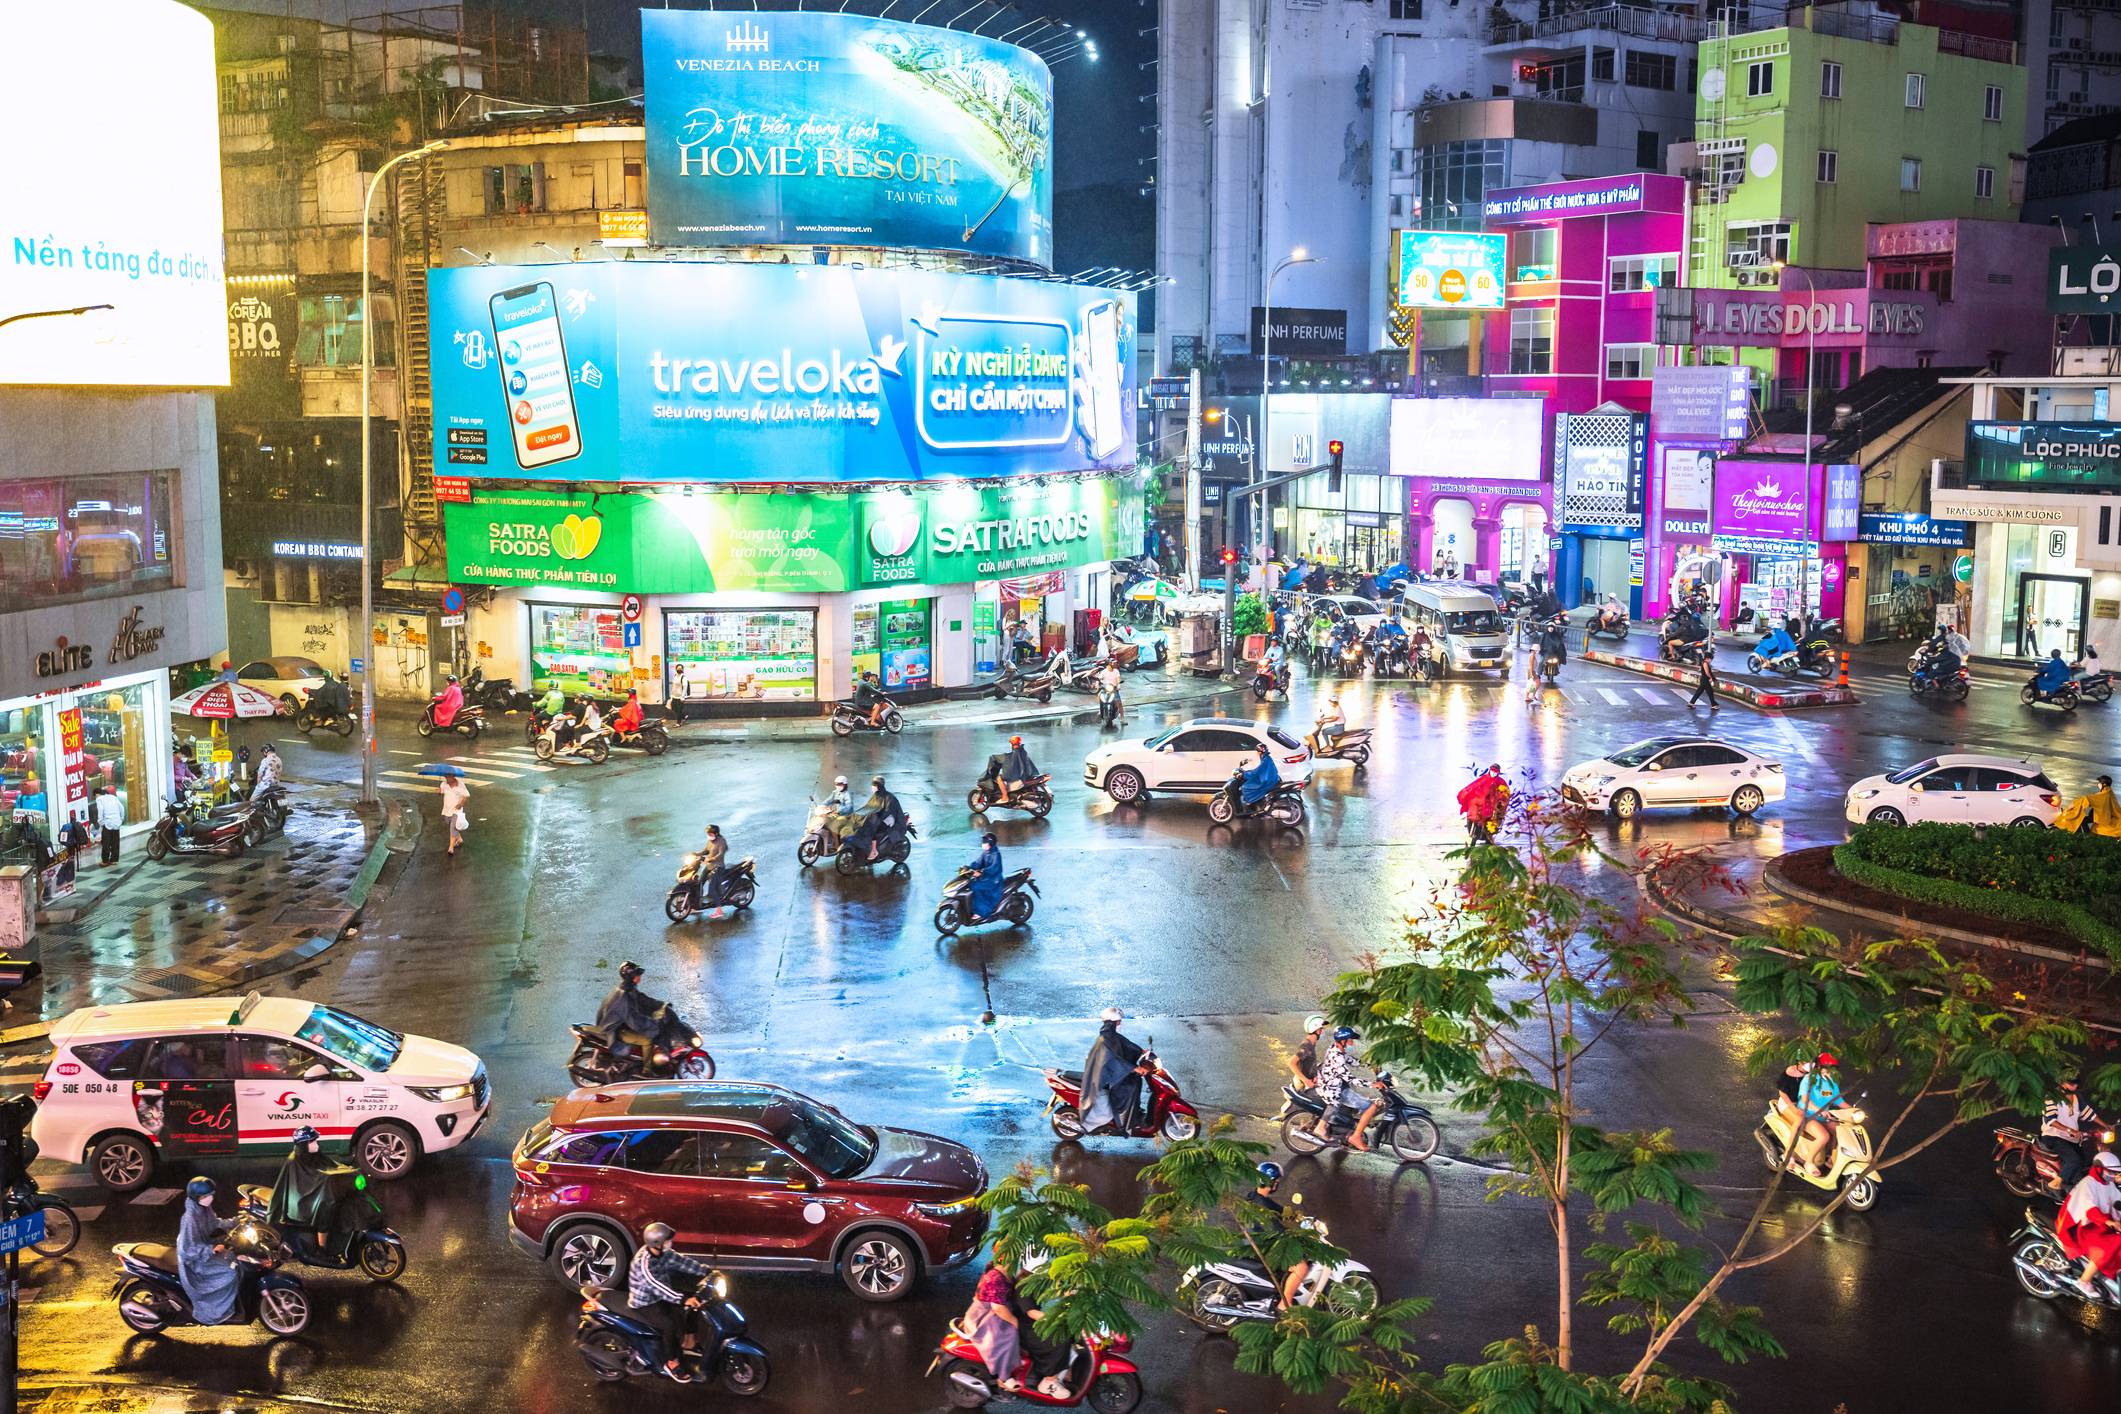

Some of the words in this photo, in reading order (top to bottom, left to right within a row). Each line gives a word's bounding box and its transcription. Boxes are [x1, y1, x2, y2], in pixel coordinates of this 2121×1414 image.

[675, 59, 754, 72] VENEZIA
[759, 59, 820, 72] BEACH
[679, 146, 807, 177] HOME
[815, 148, 962, 185] RESORT
[885, 190, 905, 203] TẠI
[907, 191, 933, 206] VIỆT
[936, 194, 957, 207] NAM
[677, 224, 765, 233] www.veneziabeach.vn
[795, 224, 873, 234] www.homeresort.vn
[14, 234, 73, 267] Nền
[82, 241, 140, 279] tảng
[148, 249, 173, 276] đa
[179, 253, 209, 286] dịch
[2059, 254, 2121, 302] LỘ
[504, 304, 542, 321] traveloka
[1725, 303, 1783, 335] EYES
[1785, 302, 1862, 335] DOLL
[1869, 303, 1924, 335] EYES
[230, 322, 280, 350] BBQ
[1261, 324, 1288, 338] LNH
[1292, 325, 1344, 340] PERFUME
[965, 346, 1012, 377] NGHỈ
[650, 349, 880, 394] traveloka
[931, 383, 967, 411] CHỈ
[654, 405, 681, 419] Siêu
[685, 406, 712, 421] ứng
[715, 405, 749, 422] dụng
[460, 435, 470, 443] App
[548, 431, 562, 443] ngay
[2023, 438, 2063, 460] LỘC
[2065, 438, 2121, 458] PHÚC
[1946, 507, 1976, 516] TRANG
[2006, 510, 2023, 518] KIM
[489, 523, 550, 540] SATRA
[934, 511, 1089, 553] SATRAFOODS
[1879, 522, 1902, 533] KHU
[1905, 520, 1928, 534] PHỐ
[1931, 525, 1938, 535] 4
[274, 543, 305, 555] KOREAN
[308, 544, 326, 556] BBQ
[328, 546, 363, 558] CONTAINE
[490, 540, 550, 557] FOODS
[787, 545, 819, 560] ngày
[873, 556, 914, 569] SATRA
[464, 563, 483, 576] CỬA
[486, 565, 512, 578] HÀNG
[515, 568, 540, 582] THỰC
[544, 566, 573, 582] PHẨM
[873, 569, 915, 581] FOODS
[60, 710, 80, 735] Sale
[62, 1084, 79, 1093] 50E
[85, 1084, 102, 1093] 050
[106, 1084, 118, 1093] 48
